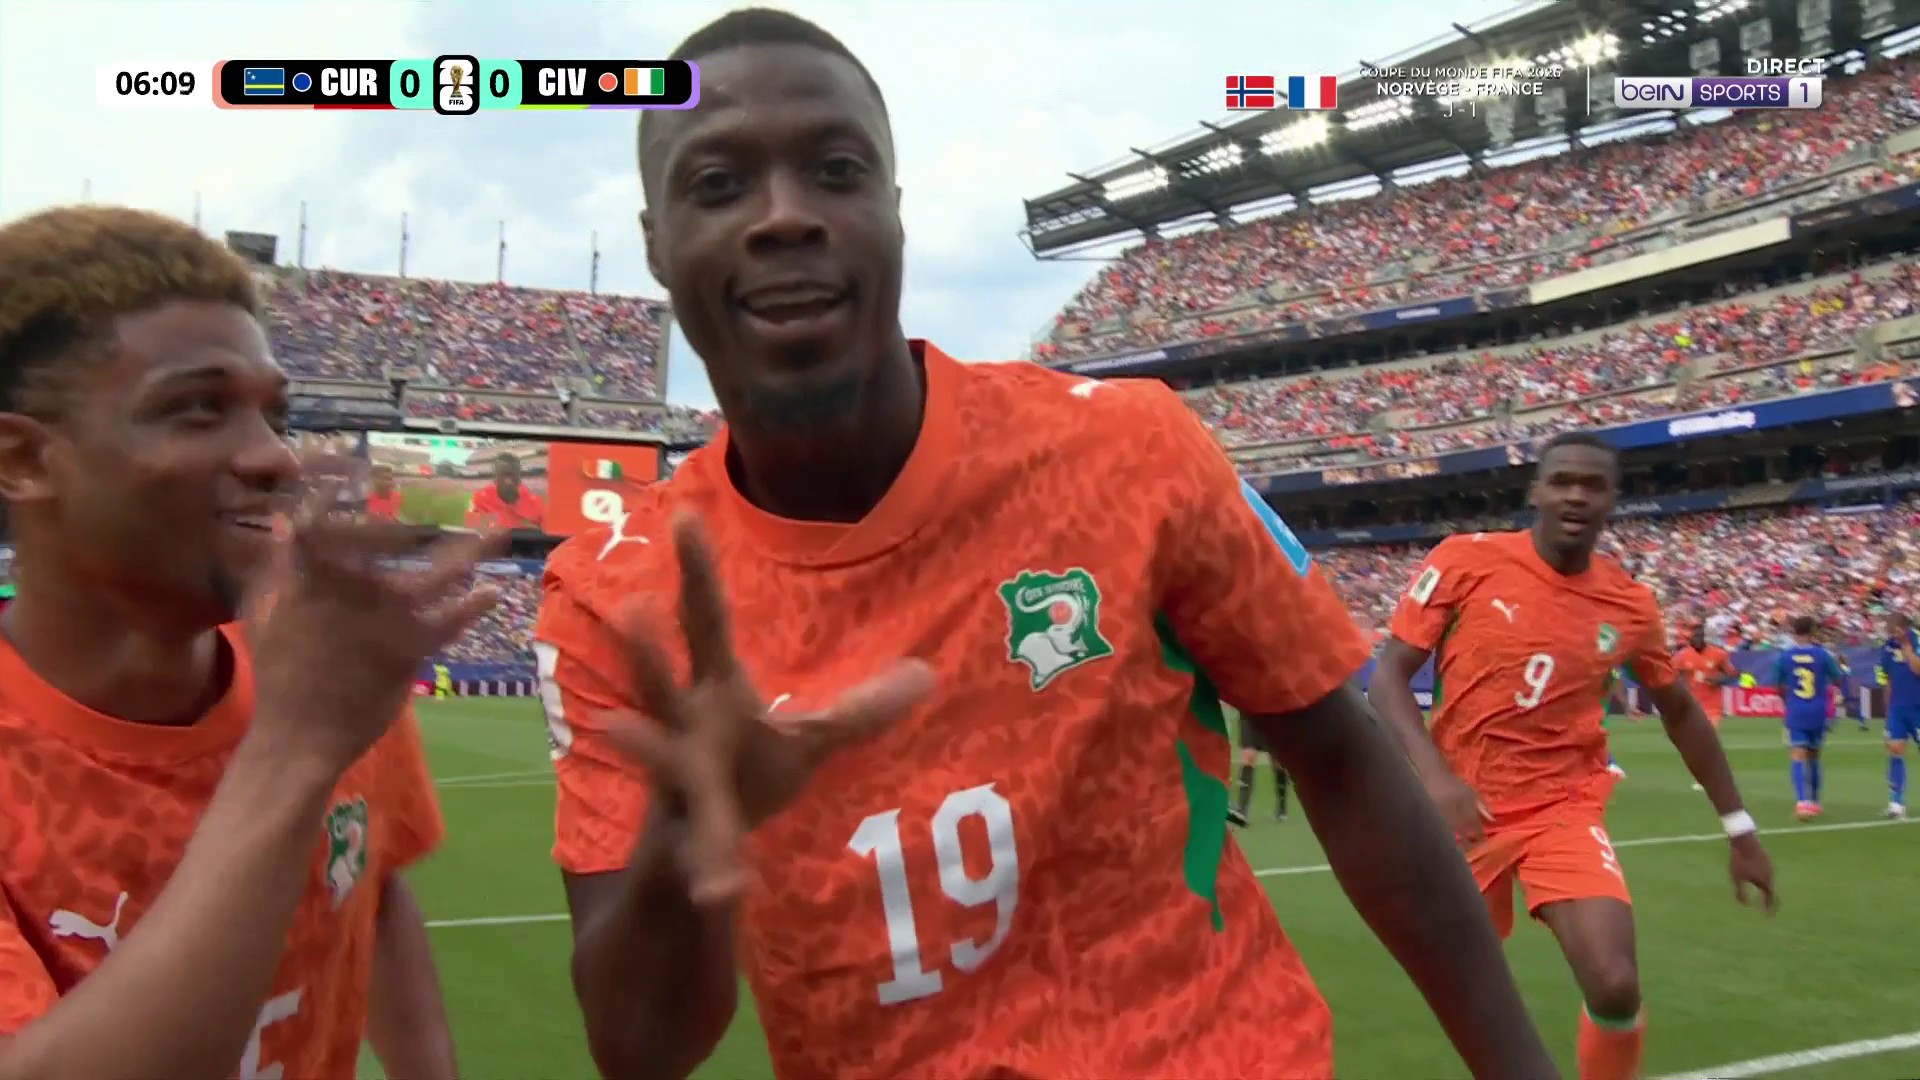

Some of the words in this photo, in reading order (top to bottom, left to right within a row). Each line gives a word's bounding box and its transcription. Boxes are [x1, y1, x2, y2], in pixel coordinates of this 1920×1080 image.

[1514, 653, 1556, 709] 9
[1793, 667, 1816, 700] 3
[847, 782, 1020, 1007] 19
